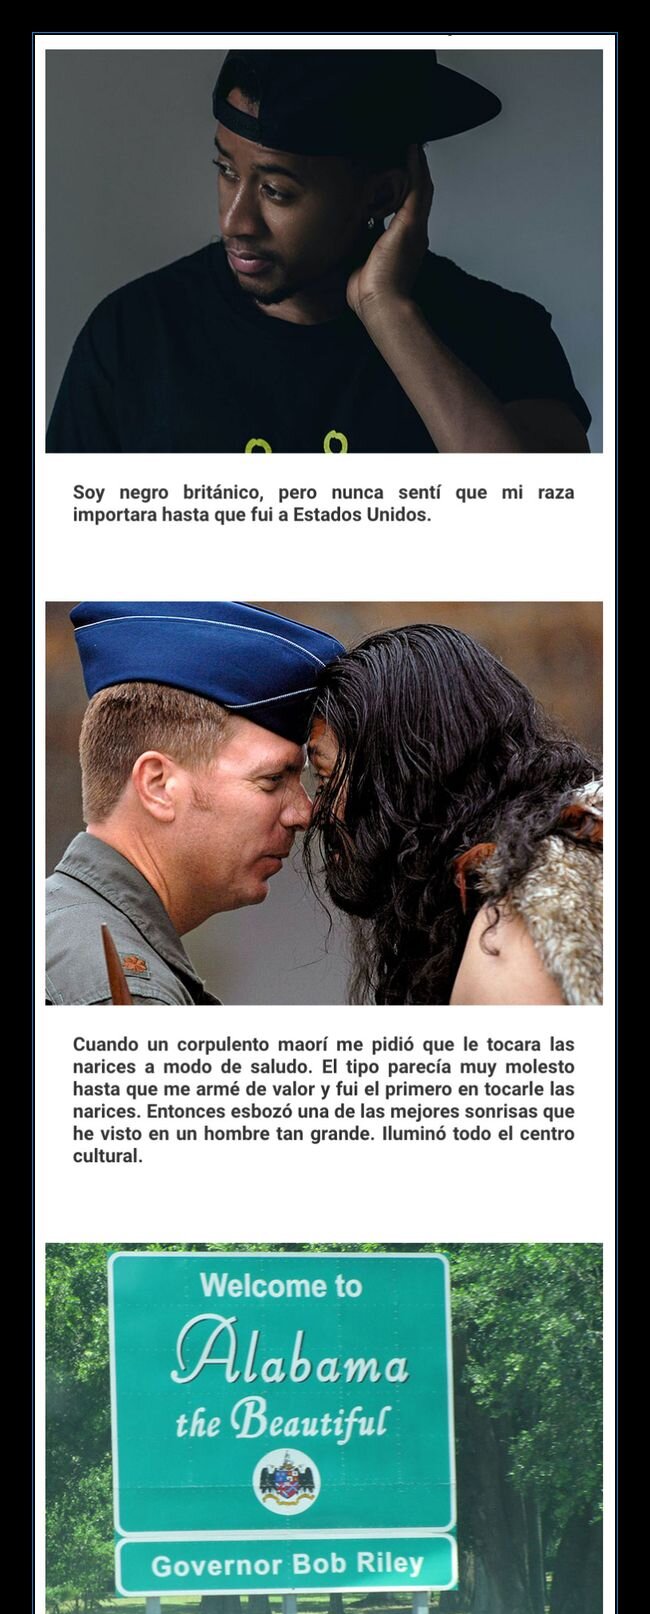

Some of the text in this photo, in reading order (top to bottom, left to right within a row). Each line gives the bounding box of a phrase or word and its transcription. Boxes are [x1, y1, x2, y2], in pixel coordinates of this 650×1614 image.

[200, 1272, 362, 1297] Welcome to
[170, 1313, 410, 1385] Alabama
[176, 1396, 392, 1445] the Beautiful
[151, 1551, 424, 1578] Governor Bob Riley
